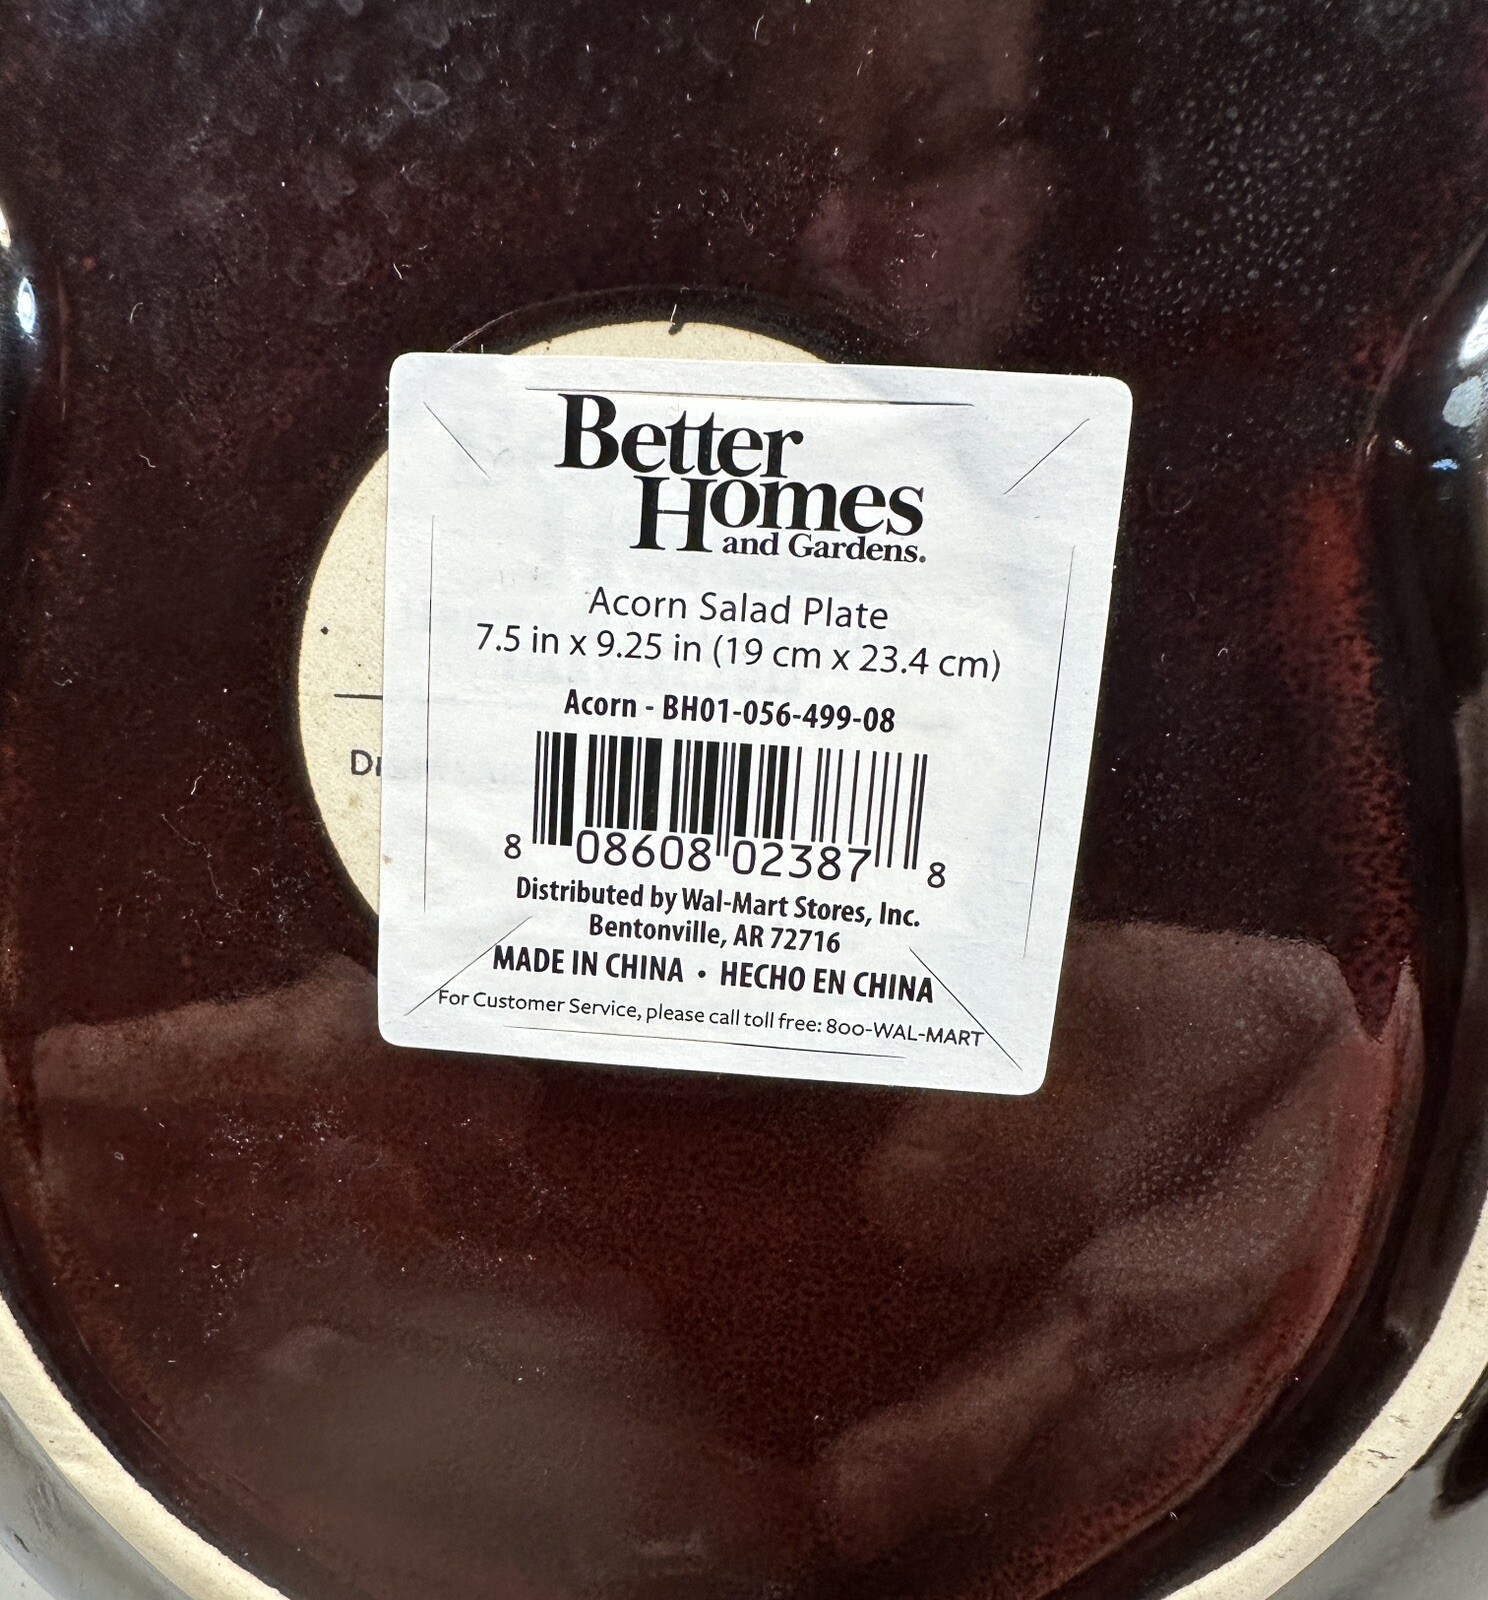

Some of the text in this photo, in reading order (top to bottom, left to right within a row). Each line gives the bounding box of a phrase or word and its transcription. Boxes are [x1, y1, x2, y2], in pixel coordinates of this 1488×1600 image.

[554, 393, 803, 478] Better
[630, 476, 923, 552] Homes
[723, 532, 779, 555] and
[589, 587, 887, 629] Acorn Salad Plate
[477, 623, 1000, 681] 7.5 in x 9.25 in (19 cm x 23.4 cm)
[564, 689, 636, 717] Acorn
[663, 695, 895, 732] BH01-056-499-08
[505, 830, 945, 888] 8 08608 02387 8
[517, 877, 919, 927] Distributed by Wal-Mart Stores, Inc.
[590, 914, 840, 953] Bentonville, AR 72716
[493, 945, 932, 1003] MADE IN CHINA HECHO EN CHINA
[438, 990, 984, 1047] For Customer Service, please call toll free: 800-WAL-MART
